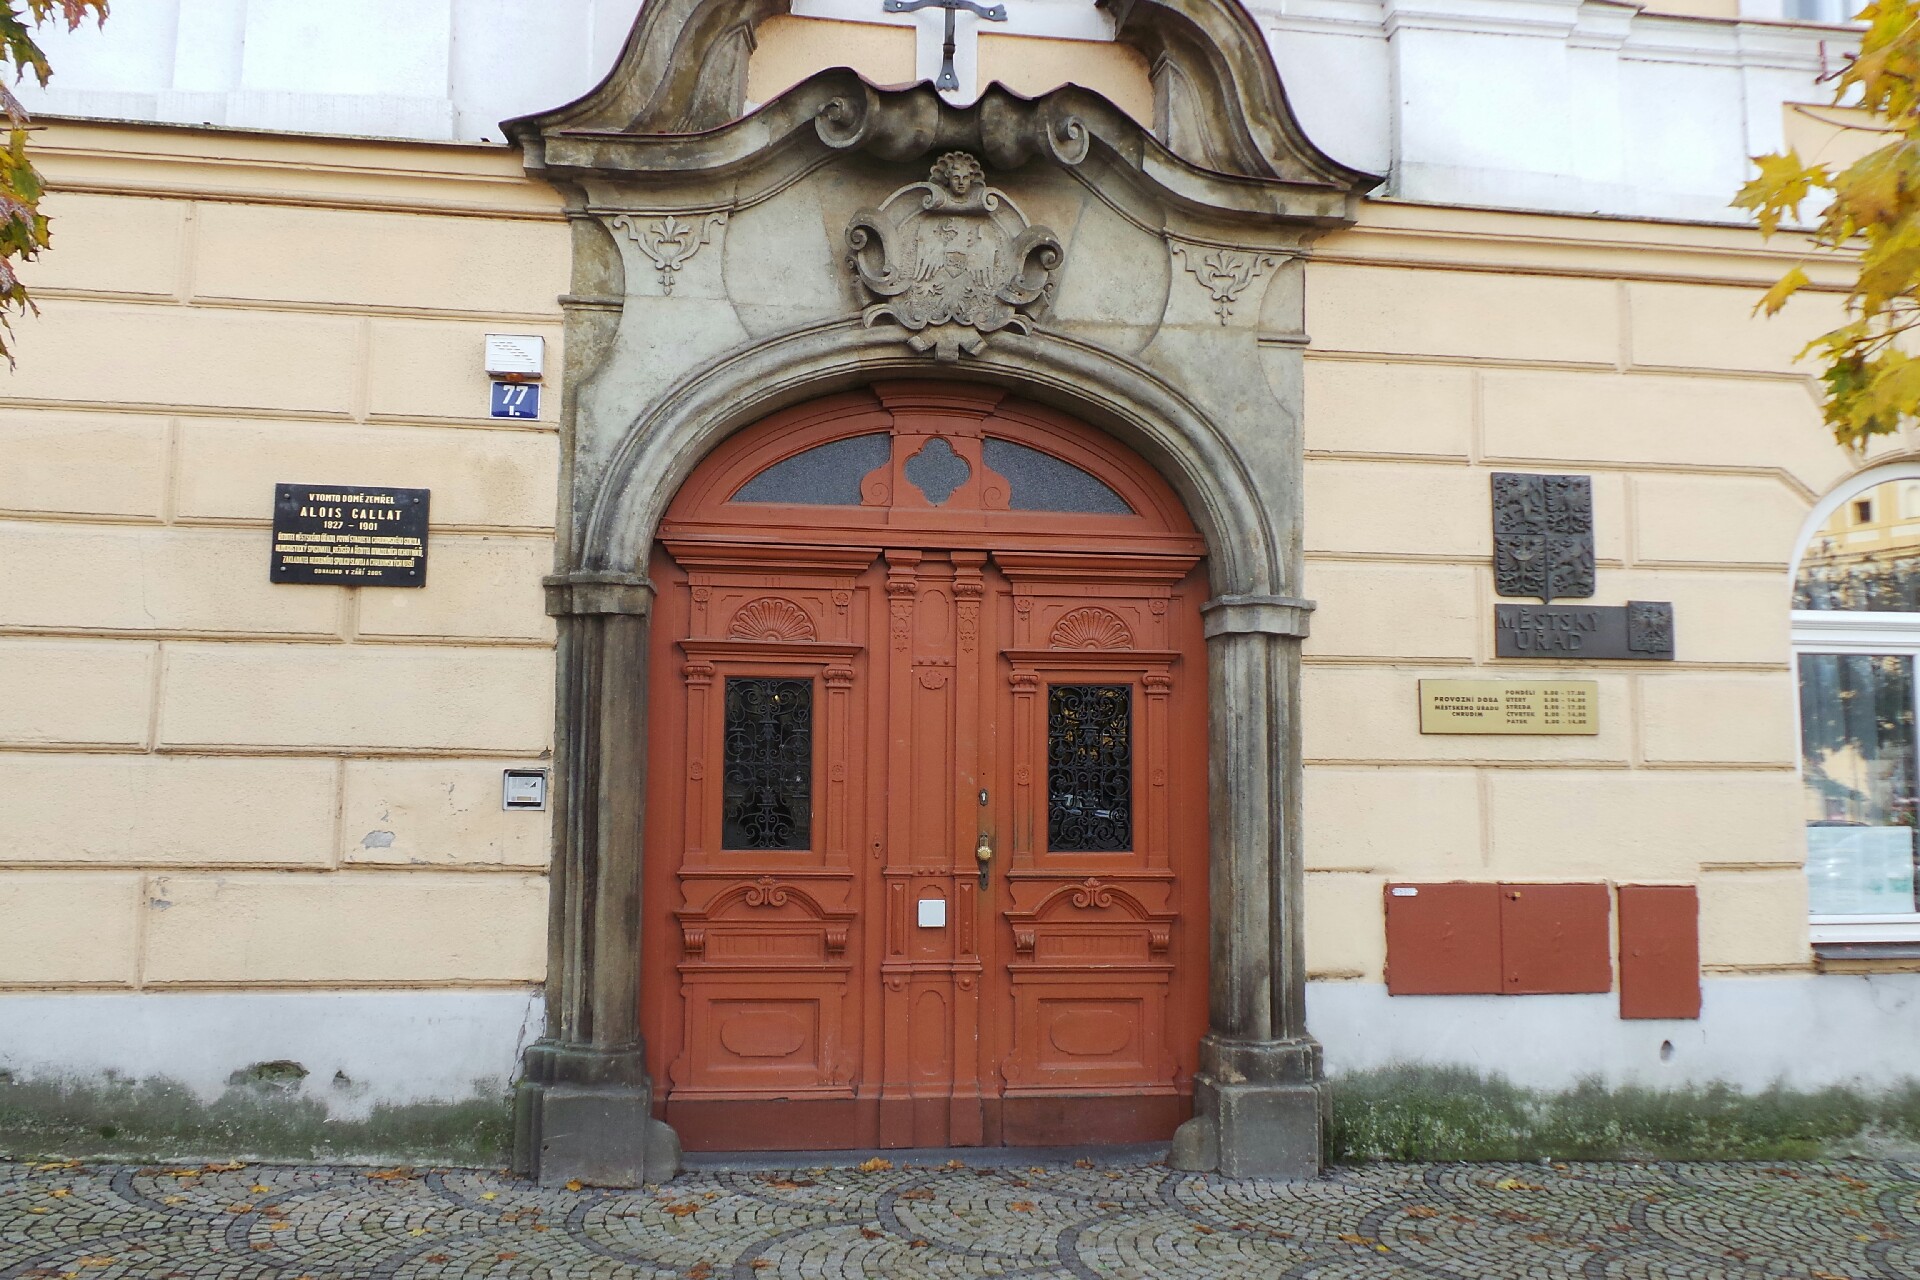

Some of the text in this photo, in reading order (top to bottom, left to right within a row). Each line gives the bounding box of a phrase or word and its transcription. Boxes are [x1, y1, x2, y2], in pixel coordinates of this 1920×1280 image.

[502, 385, 528, 404] 77
[299, 506, 402, 521] ALOIS GALLAT
[323, 521, 344, 530] 1827
[359, 521, 378, 531] 1901
